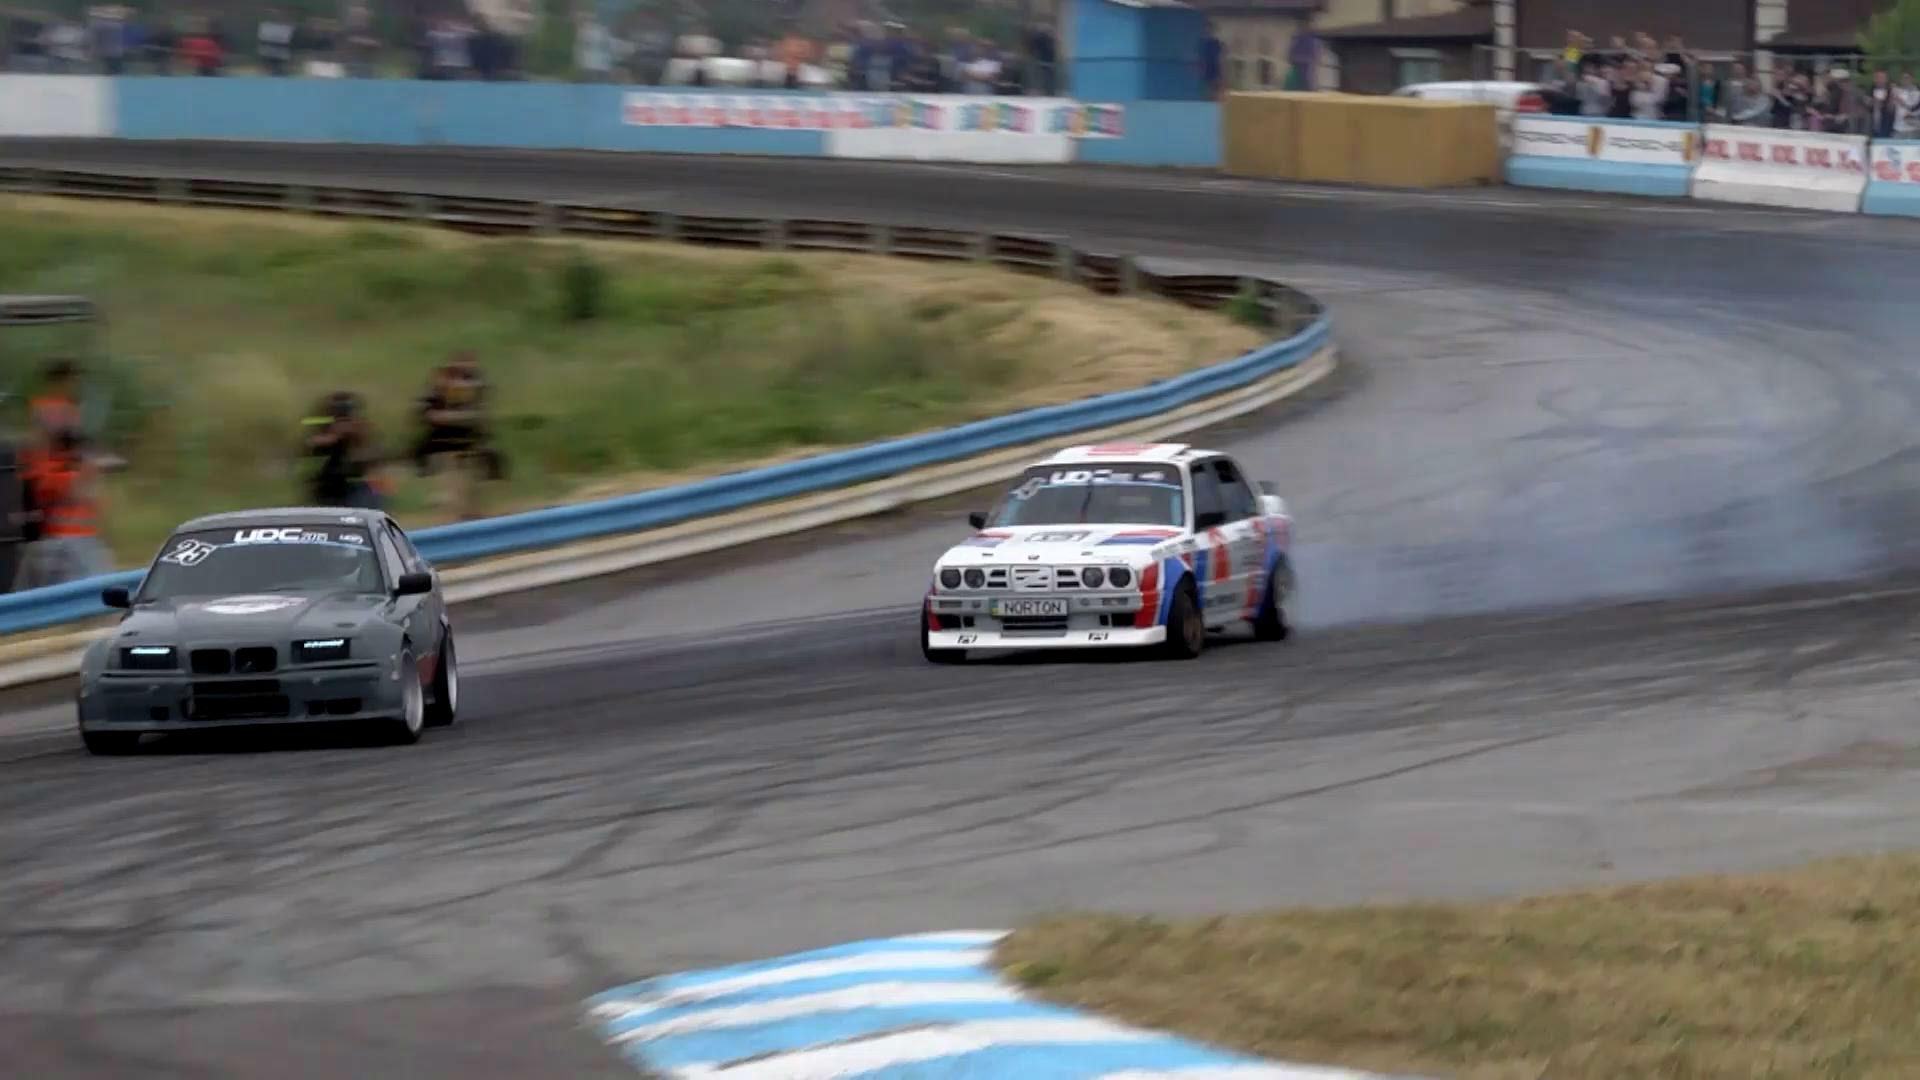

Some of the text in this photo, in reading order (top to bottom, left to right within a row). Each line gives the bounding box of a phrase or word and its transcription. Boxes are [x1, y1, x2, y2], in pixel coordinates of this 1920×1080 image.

[234, 528, 303, 543] UDC
[175, 539, 216, 566] 25
[1003, 601, 1062, 615] NORTON
